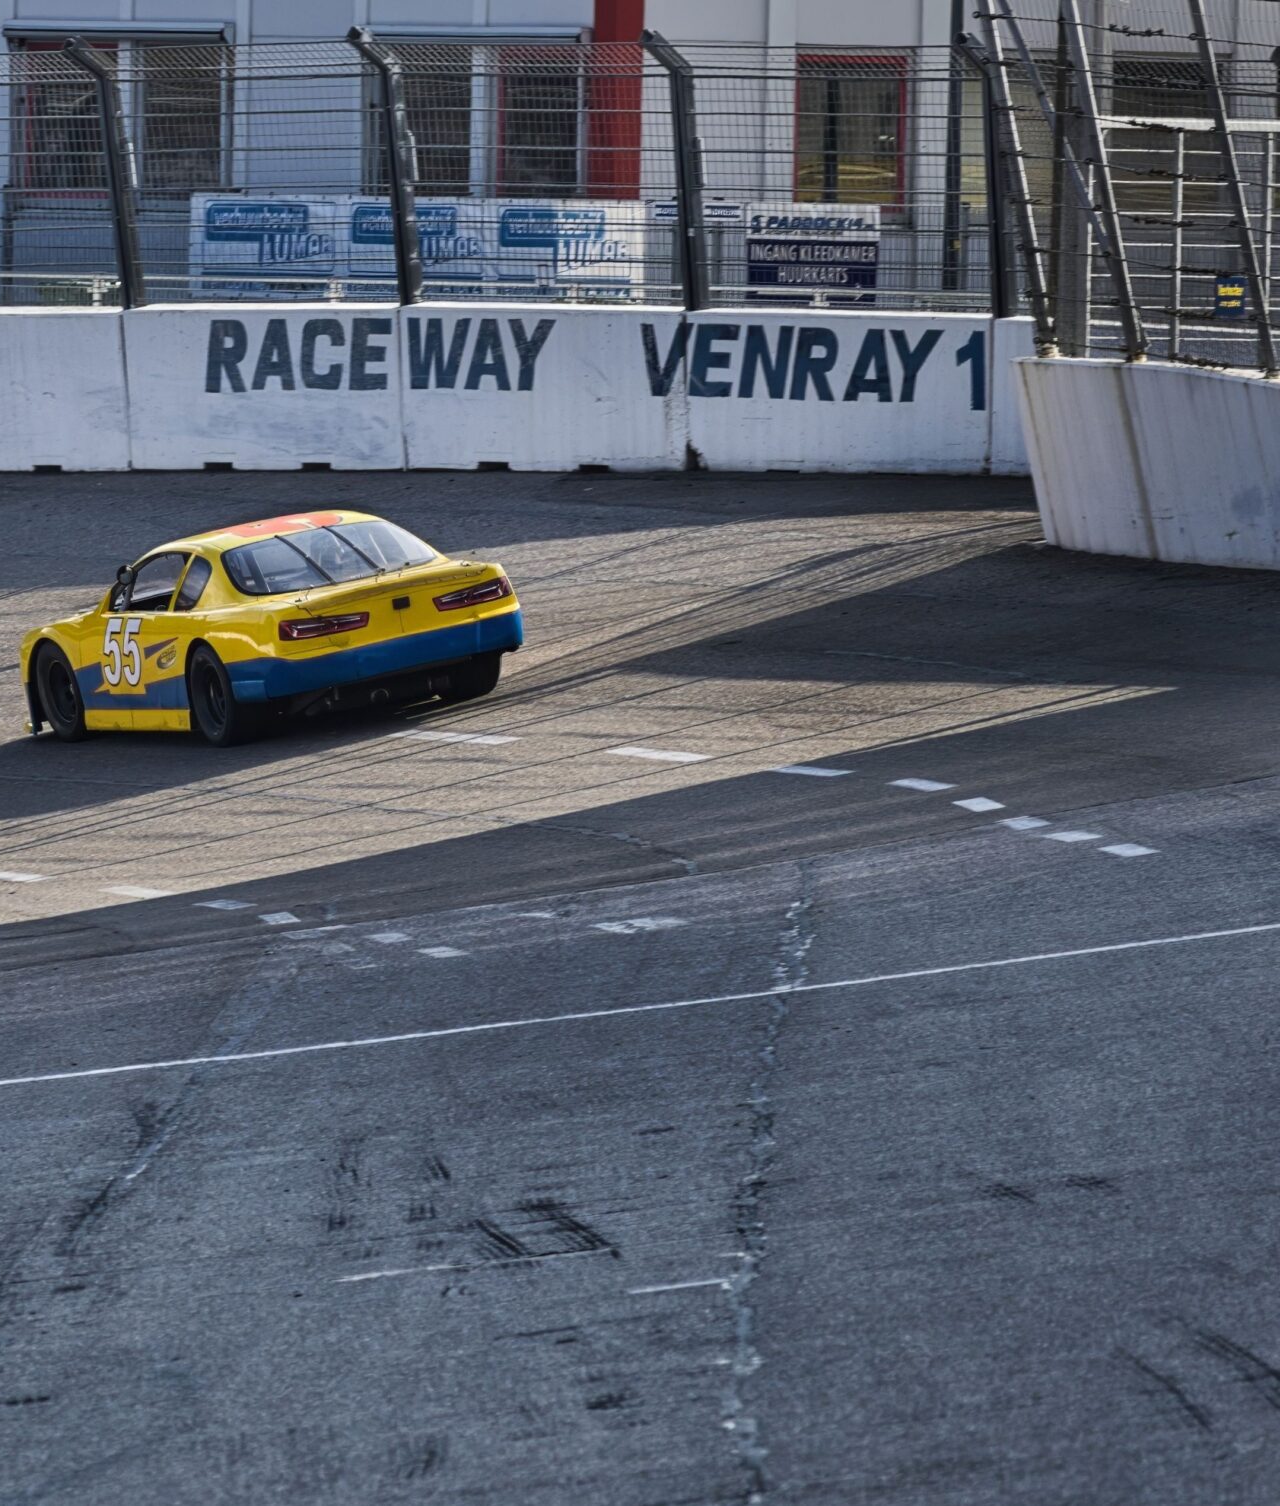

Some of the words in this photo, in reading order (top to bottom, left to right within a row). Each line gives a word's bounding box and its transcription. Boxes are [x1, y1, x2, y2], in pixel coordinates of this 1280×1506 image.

[750, 243, 798, 261] INGANG
[798, 245, 877, 263] KLEEDKAMER
[777, 265, 849, 284] HUURKARTS
[640, 323, 945, 402] VENRAY
[956, 330, 986, 411] 1
[103, 617, 143, 686] 55
